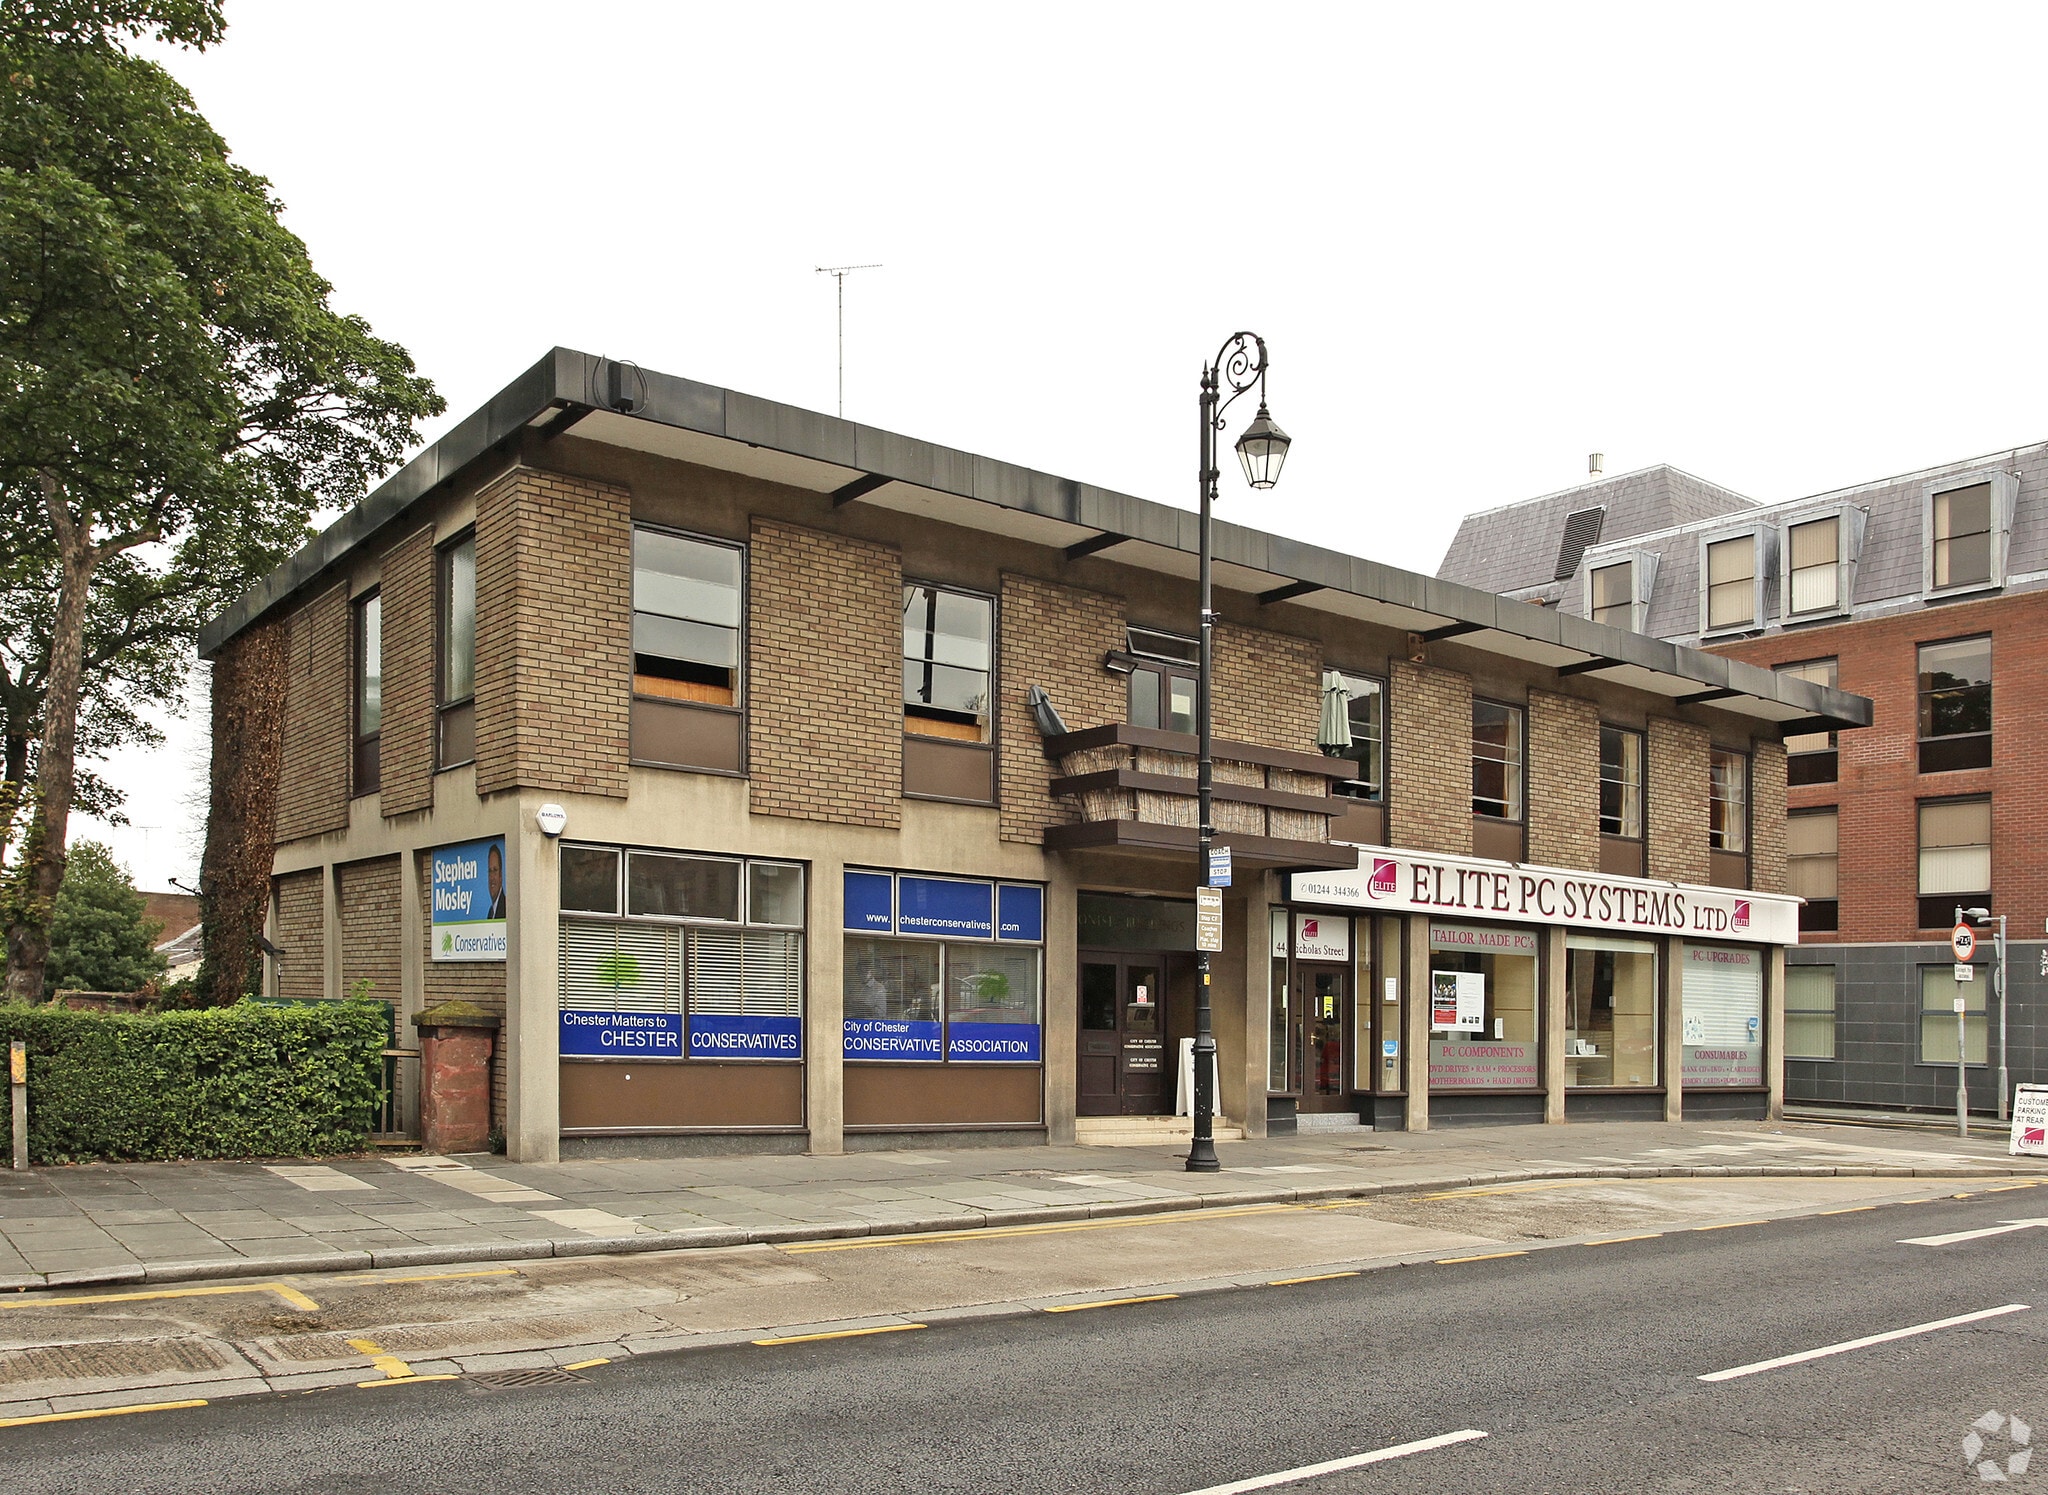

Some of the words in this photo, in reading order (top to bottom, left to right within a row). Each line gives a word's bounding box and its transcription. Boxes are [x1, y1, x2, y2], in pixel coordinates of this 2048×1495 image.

[1210, 848, 1229, 856] COACH
[435, 855, 477, 887] Stephen
[1213, 868, 1228, 876] STOP
[1308, 883, 1330, 895] 01244
[1333, 885, 1360, 898] 344366
[1374, 880, 1397, 892] ELITE
[435, 885, 473, 915] Mosley
[1410, 863, 1510, 912] ELITE
[1518, 875, 1556, 916] PC
[1563, 881, 1686, 929] SYSTEMS
[1693, 905, 1728, 932] LTD
[866, 913, 891, 924] www.
[899, 914, 991, 931] chesterconservatives
[999, 922, 1020, 932] .com
[1734, 917, 1750, 927] ELITE
[454, 934, 506, 952] Conservatives
[1433, 929, 1475, 945] TAILOR
[1479, 933, 1510, 947] MADE
[1514, 935, 1535, 949] PC's
[1295, 943, 1322, 955] icholas
[1323, 945, 1344, 957] Street
[1693, 950, 1704, 961] PC
[1707, 951, 1750, 964] UPGRADES
[563, 1012, 611, 1026] Chester
[611, 1014, 655, 1027] Matters
[656, 1016, 667, 1028] to
[843, 1020, 861, 1034] City
[863, 1022, 873, 1032] of
[874, 1022, 910, 1033] Chester
[600, 1030, 678, 1048] CHESTER
[691, 1032, 797, 1050] CONSERVATIVES
[843, 1037, 941, 1052] CONSERVATIVE
[949, 1040, 1029, 1053] ASSOCIATION
[1442, 1046, 1456, 1057] PC
[1458, 1046, 1525, 1058] COMPONENTS
[1694, 1050, 1748, 1060] CONSUMABLES
[1445, 1065, 1469, 1073] DRIVES
[1476, 1065, 1491, 1073] RAM
[1497, 1065, 1537, 1073] PROCESSORS
[2017, 1107, 2046, 1115] PARKING
[2026, 1116, 2044, 1124] REAR
